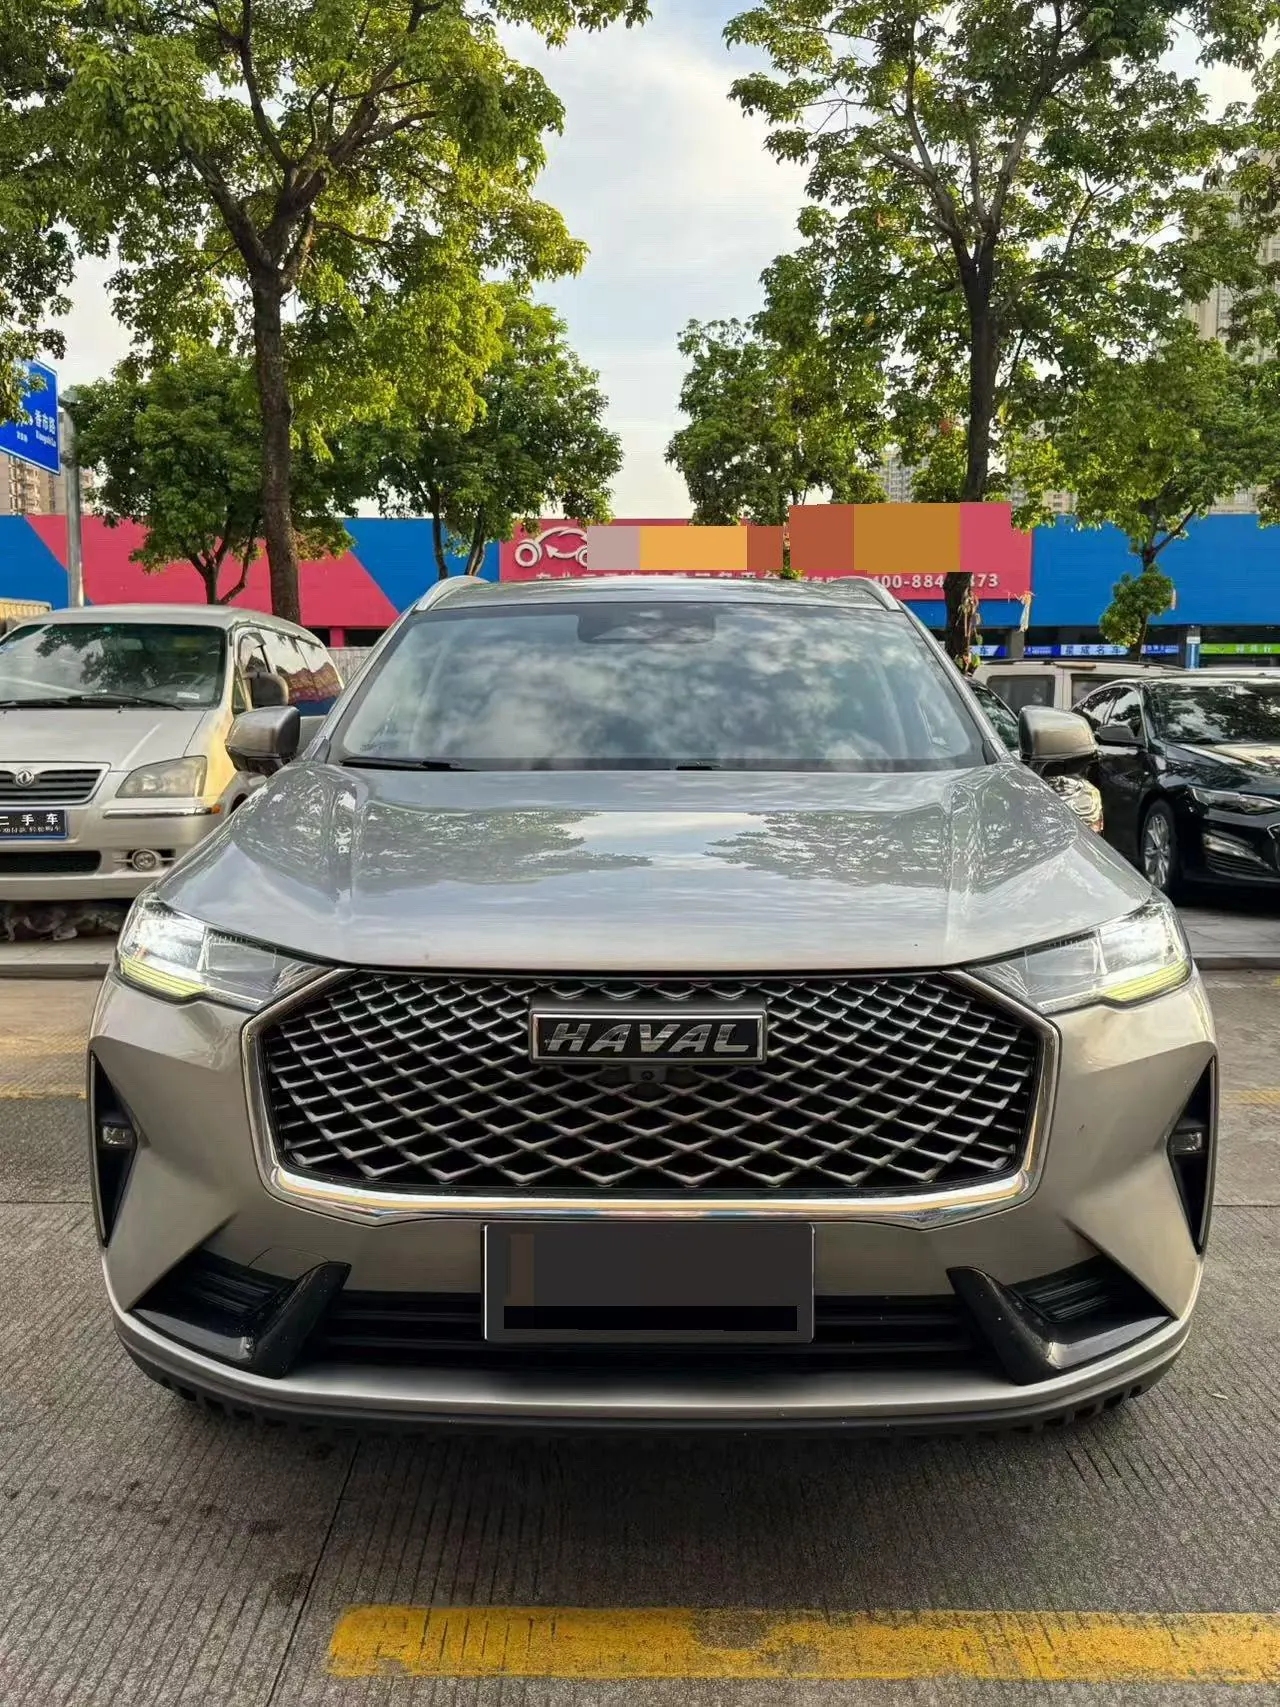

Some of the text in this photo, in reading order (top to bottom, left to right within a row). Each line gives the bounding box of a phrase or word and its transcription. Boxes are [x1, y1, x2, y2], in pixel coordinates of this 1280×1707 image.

[0, 813, 59, 826] 二手车
[547, 1023, 749, 1053] HAVAL
